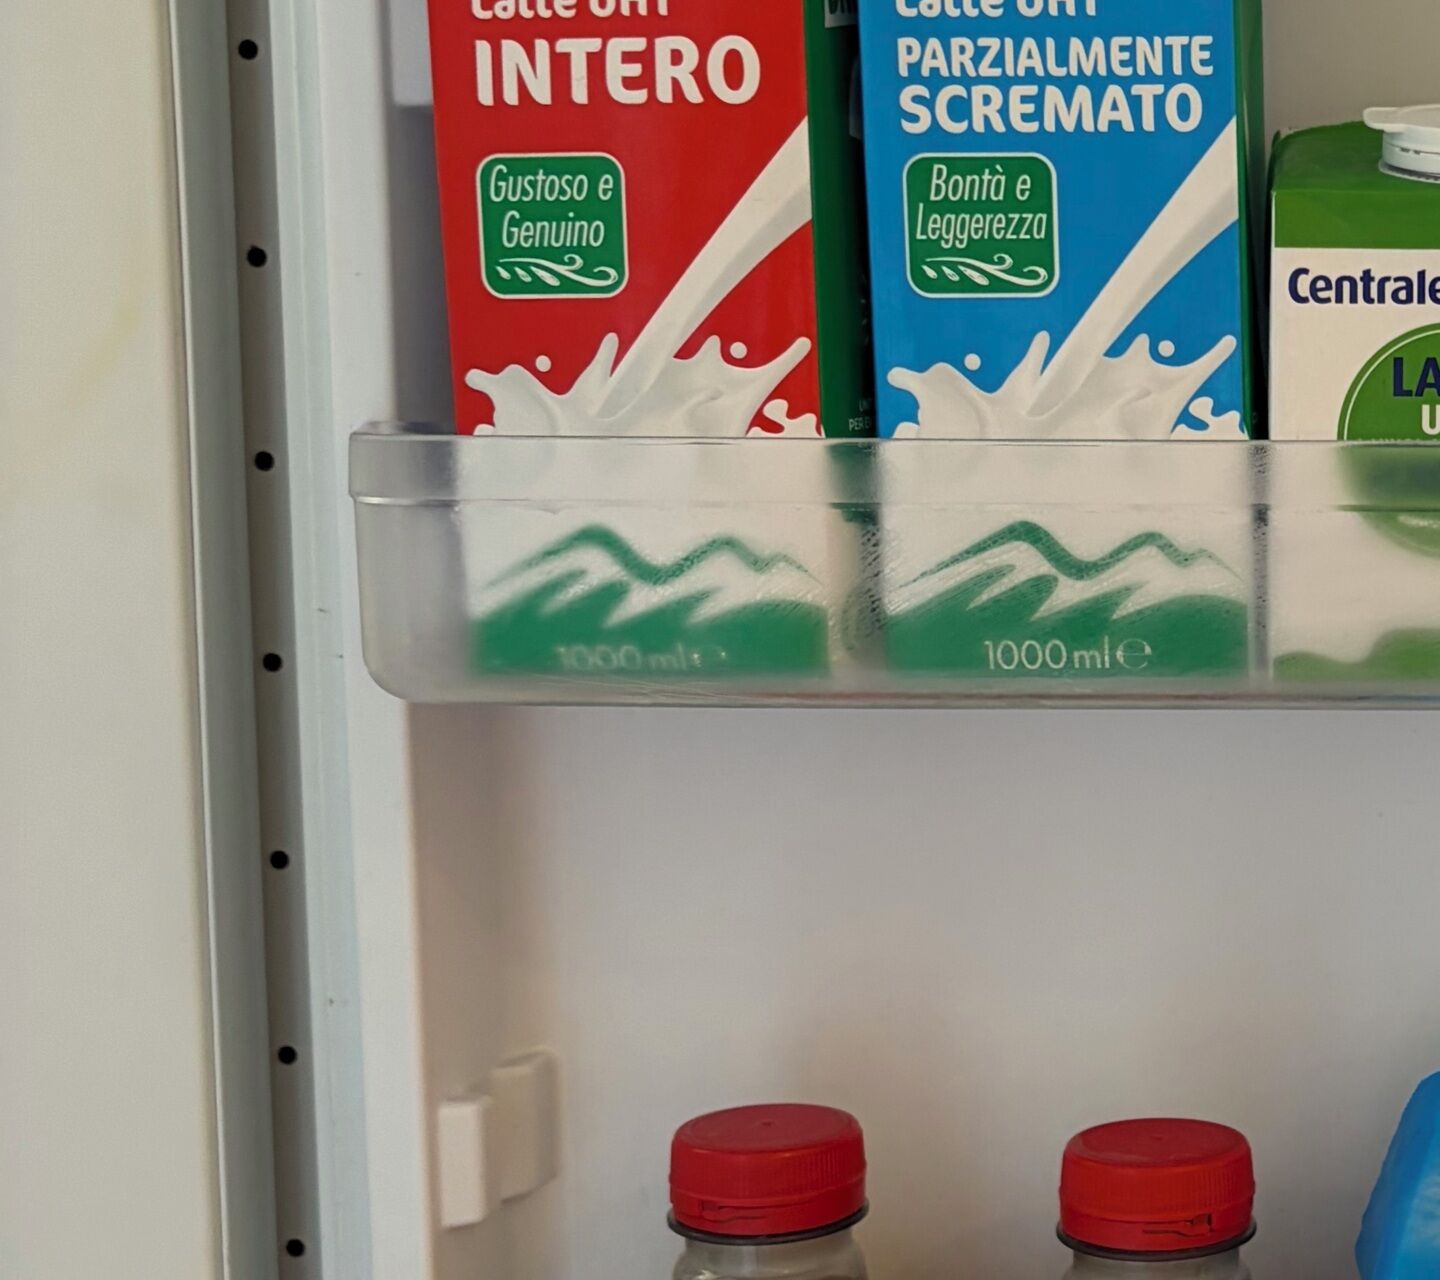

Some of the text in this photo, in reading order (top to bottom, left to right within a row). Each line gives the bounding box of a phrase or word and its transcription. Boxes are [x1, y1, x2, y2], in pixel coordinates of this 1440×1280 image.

[475, 35, 761, 106] INTERO
[897, 36, 1214, 77] PARZIALMENTE
[900, 83, 1202, 134] SCREMATO
[490, 164, 613, 202] Gustoso e
[930, 164, 1031, 201] Bontà e
[502, 210, 605, 249] Genuino
[916, 203, 1047, 250] Leggerezza
[984, 640, 1067, 670] 1000
